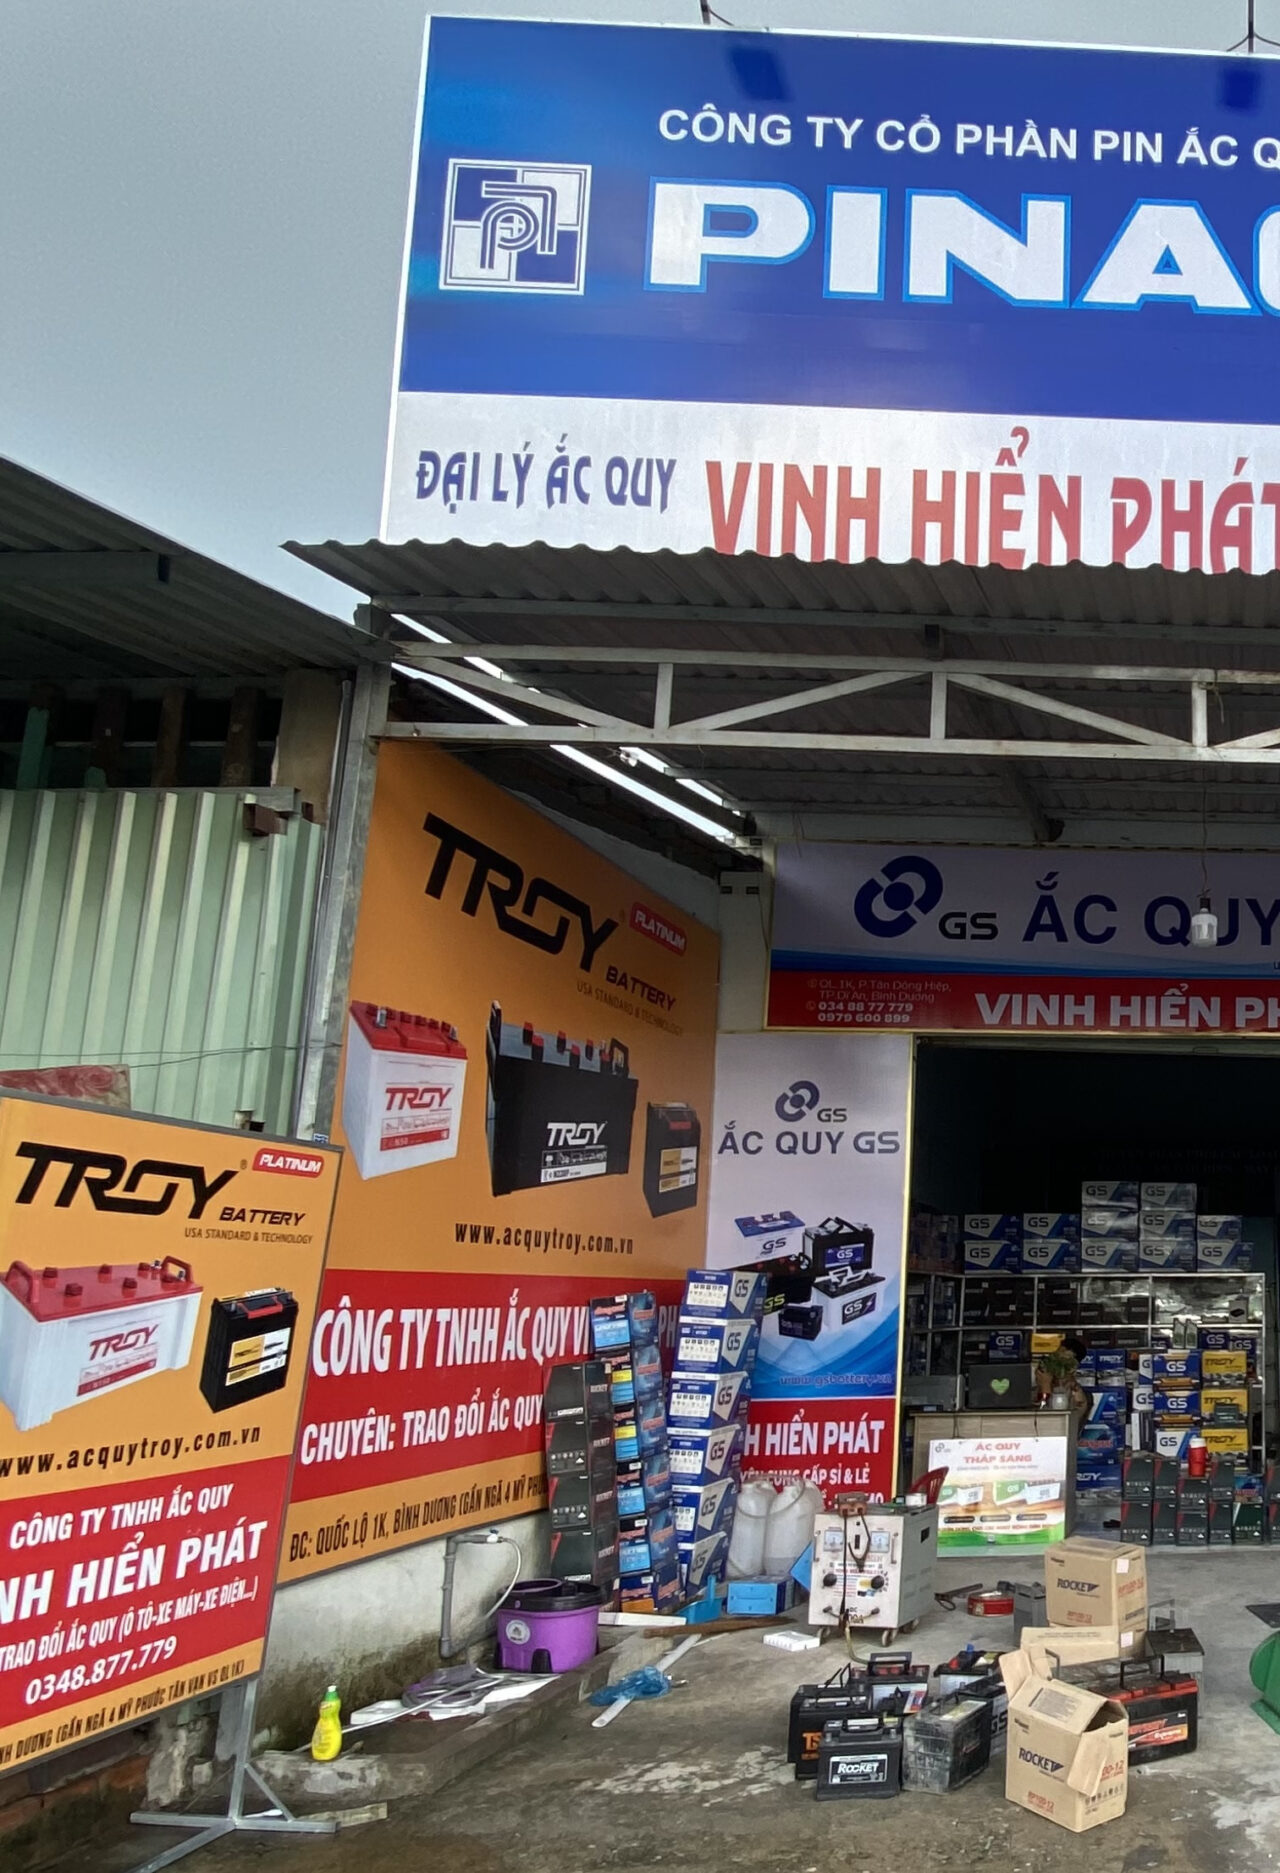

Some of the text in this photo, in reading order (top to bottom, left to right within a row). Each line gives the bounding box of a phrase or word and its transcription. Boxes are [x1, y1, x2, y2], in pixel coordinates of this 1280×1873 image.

[659, 103, 791, 146] CÔNG
[806, 115, 864, 150] TY
[876, 114, 941, 153] CỔ
[957, 117, 1077, 160] PHẦN
[1093, 129, 1163, 164] PIN
[1177, 126, 1239, 167] ẮC
[415, 432, 677, 514] ĐẠI LÝ ẮC QUY
[705, 460, 881, 562] VINH
[911, 426, 1081, 569] HIỂN
[423, 812, 619, 973] TROY
[1022, 871, 1117, 944] ẮC
[636, 910, 685, 948] PLATINUM
[938, 911, 998, 940] GS
[606, 965, 676, 1012] BATTERY
[819, 1002, 913, 1012] 034 77 779
[975, 993, 1096, 1026] VINH
[1109, 983, 1221, 1028] HIỂN
[385, 1087, 453, 1111] TROY
[817, 1108, 847, 1123] GS
[546, 1122, 606, 1146] TROY
[718, 1120, 900, 1155] ẮC QUY GS
[259, 1153, 322, 1173] PLATINUM
[15, 1141, 240, 1219] TROY
[1086, 1184, 1108, 1196] GS
[219, 1206, 305, 1227] BATTERY
[969, 1218, 990, 1229] GS
[184, 1228, 313, 1245] USA STANDARD TECHNOLOGY
[454, 1222, 633, 1255] www.acquytroy.com.vn
[836, 1249, 854, 1259] GS
[1028, 1247, 1049, 1258] GS
[1202, 1247, 1222, 1257] GS
[735, 1280, 748, 1297] GS
[844, 1300, 863, 1315] GS
[89, 1324, 160, 1361] TROY
[312, 1295, 392, 1378] CÔNG
[399, 1308, 432, 1371] TY
[436, 1307, 499, 1368] TNHH
[501, 1288, 529, 1362] ẮC
[532, 1306, 571, 1366] QUY
[727, 1333, 740, 1350] GS
[995, 1335, 1014, 1346] GS
[1207, 1335, 1224, 1344] GS
[1100, 1355, 1124, 1363] TROY
[1166, 1361, 1186, 1372] GS
[1205, 1358, 1235, 1366] TROY
[300, 1387, 544, 1466] CHUYÊN: TRAO ĐỔI ẮC QUY
[765, 1408, 885, 1456] HIỂN PHÁT
[711, 1441, 725, 1461] GS
[996, 1443, 1020, 1451] QUY
[1160, 1437, 1177, 1446] GS
[845, 1470, 853, 1484] &
[10, 1483, 234, 1550] CÔNG TY TNHH ẮC QUY
[290, 1500, 419, 1562] ĐC: QUỐC LỘ BÌNH
[66, 1517, 269, 1608] HIỂN PHÁT
[1056, 1578, 1099, 1592] ROCKET
[37, 1618, 117, 1662] ĐỔI ẮC QUY
[25, 1635, 178, 1706] 0348.877.779
[838, 1762, 879, 1774] ROCKET
[1019, 1747, 1064, 1772] ROCKET
